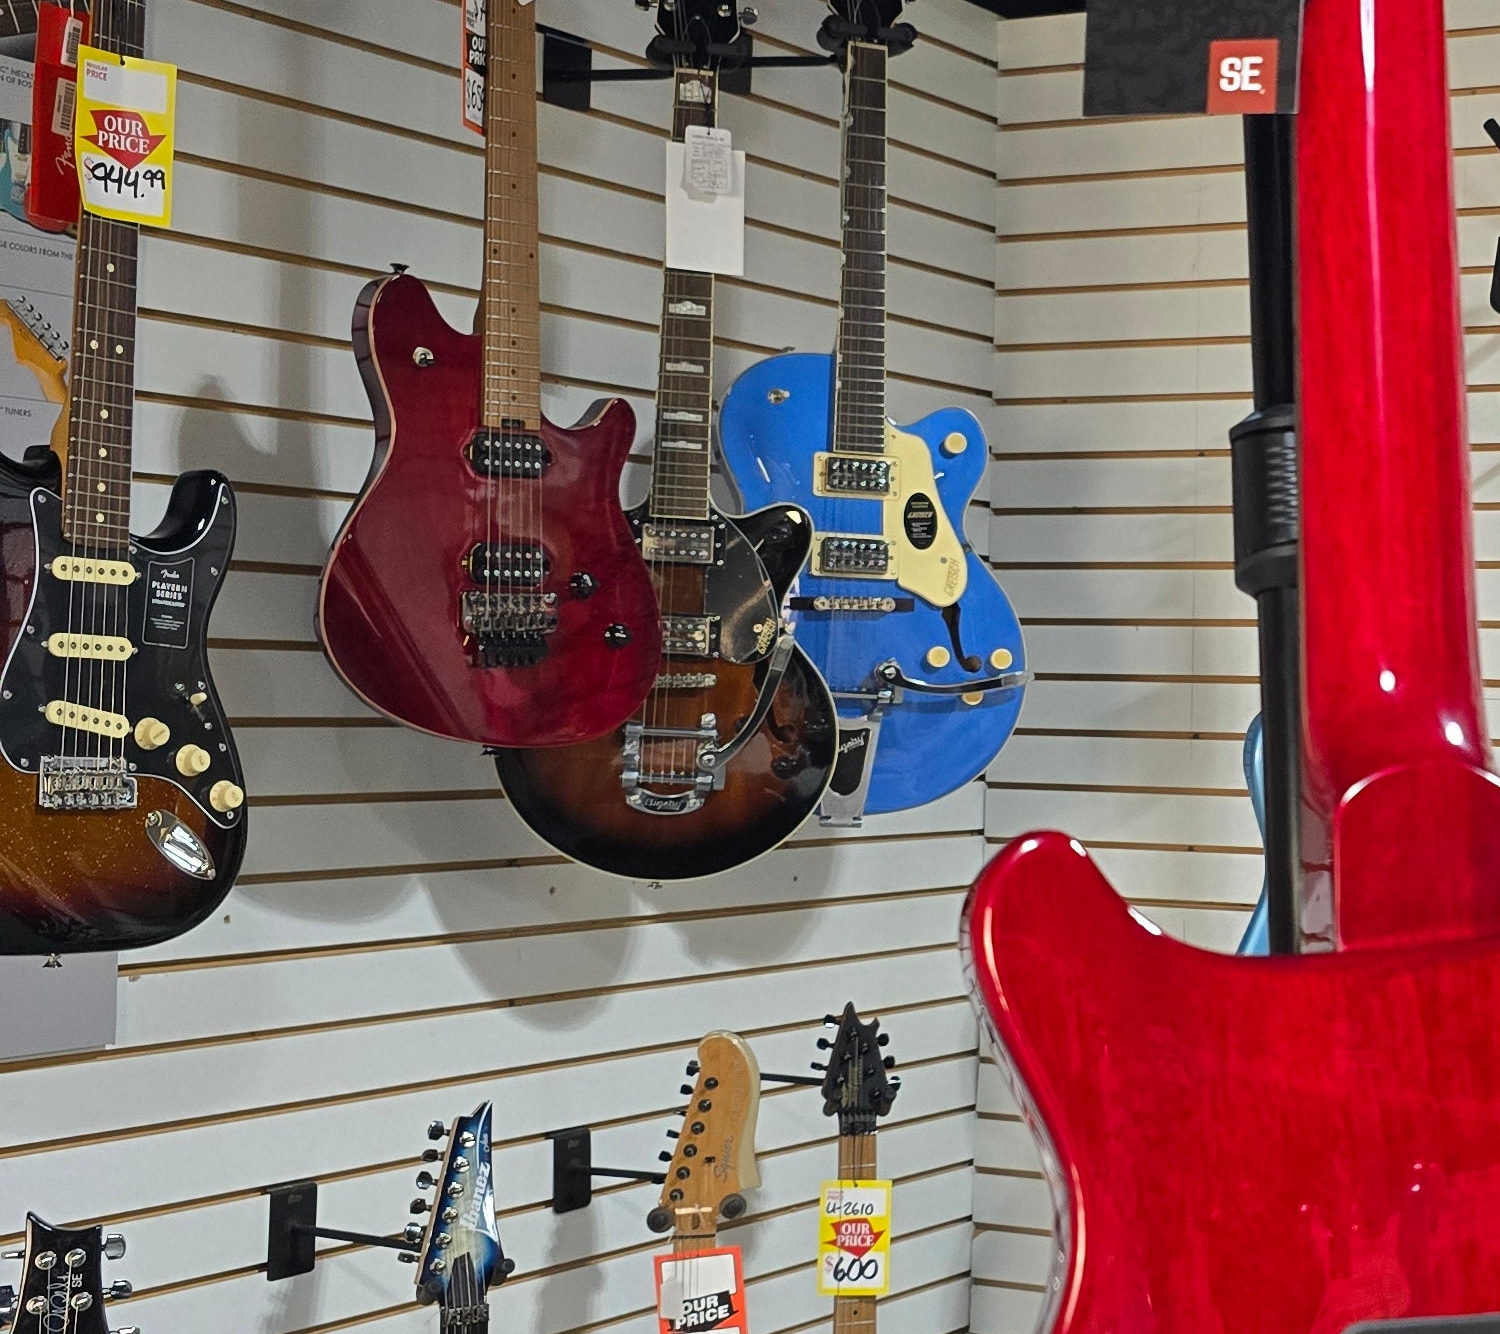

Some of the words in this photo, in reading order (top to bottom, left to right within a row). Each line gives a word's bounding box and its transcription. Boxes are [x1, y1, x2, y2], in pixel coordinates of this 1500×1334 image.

[86, 69, 108, 82] PRICE
[1219, 56, 1264, 92] SE
[104, 115, 143, 137] OUR
[97, 130, 150, 155] PRICE
[5, 407, 32, 417] TUNERS
[459, 1161, 491, 1229] Ibanez
[841, 1222, 870, 1235] OUR
[836, 1234, 875, 1247] PRICE
[824, 1255, 879, 1282] $600
[72, 1273, 84, 1288] SE
[675, 1304, 730, 1330] PRICE
[682, 1295, 718, 1317] OUR
